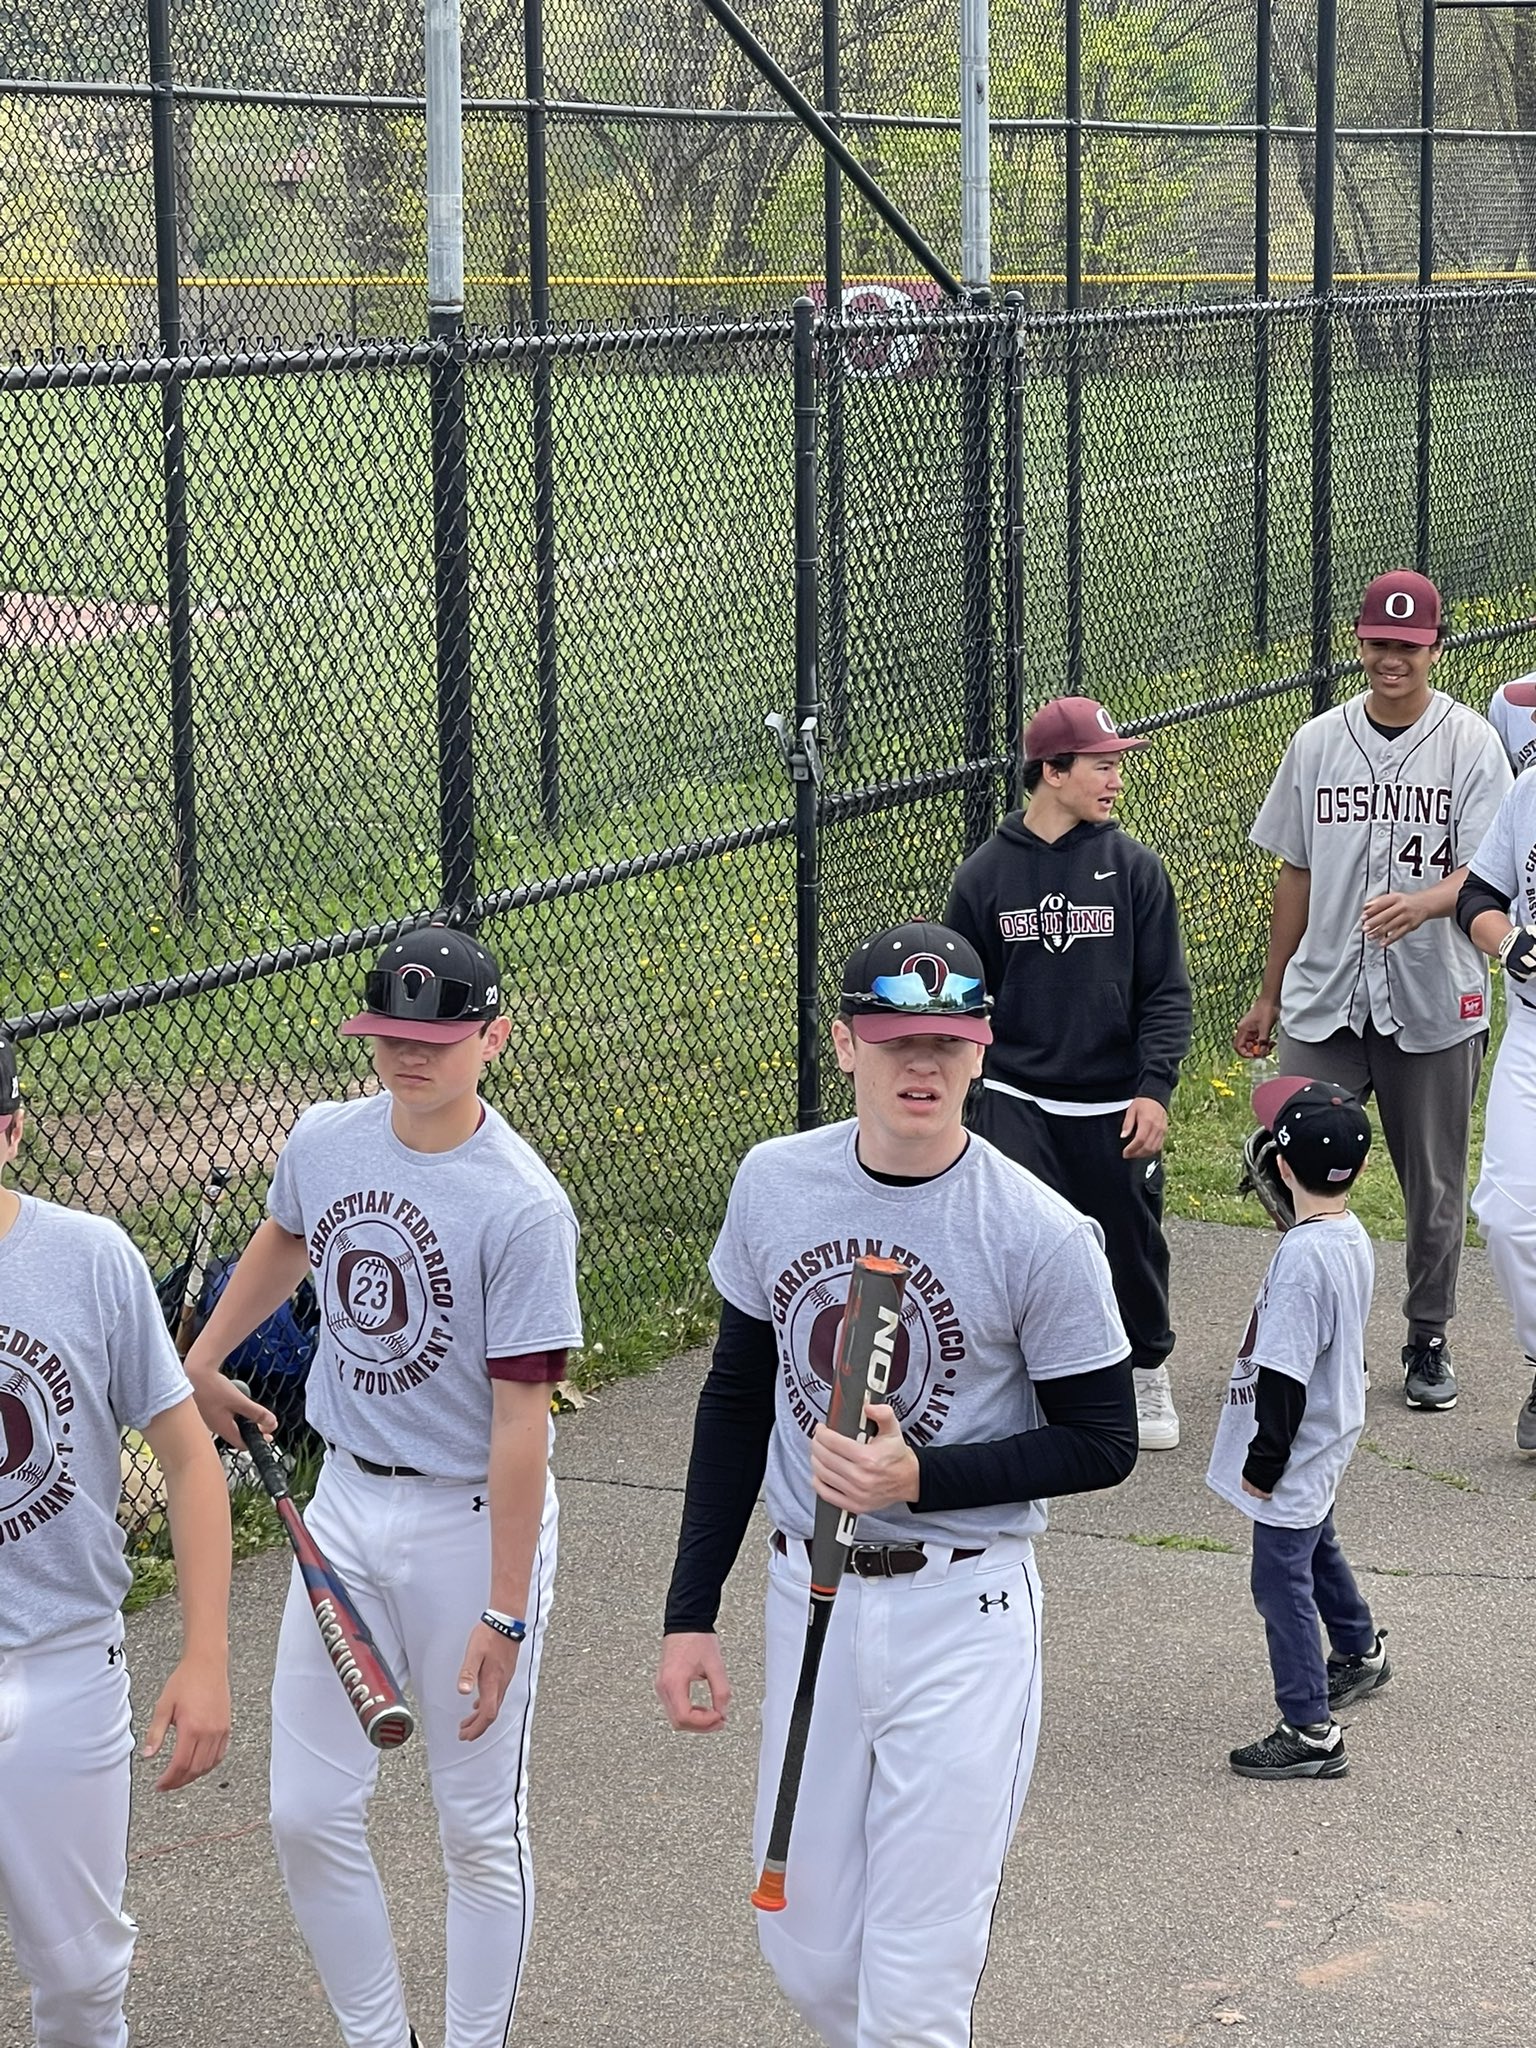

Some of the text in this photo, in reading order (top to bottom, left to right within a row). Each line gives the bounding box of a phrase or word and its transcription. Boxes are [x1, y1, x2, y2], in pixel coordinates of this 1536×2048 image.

[1384, 592, 1415, 619] O
[1096, 706, 1118, 733] O
[1317, 782, 1453, 826] OSSINING
[1397, 832, 1454, 880] 44
[1048, 896, 1063, 910] O
[309, 1190, 454, 1310] CHRISTIAN FEDERICO
[352, 1276, 389, 1311] 23
[772, 1238, 967, 1363] CHRISTIAN FEDERICO
[314, 1597, 386, 1717] marucci
